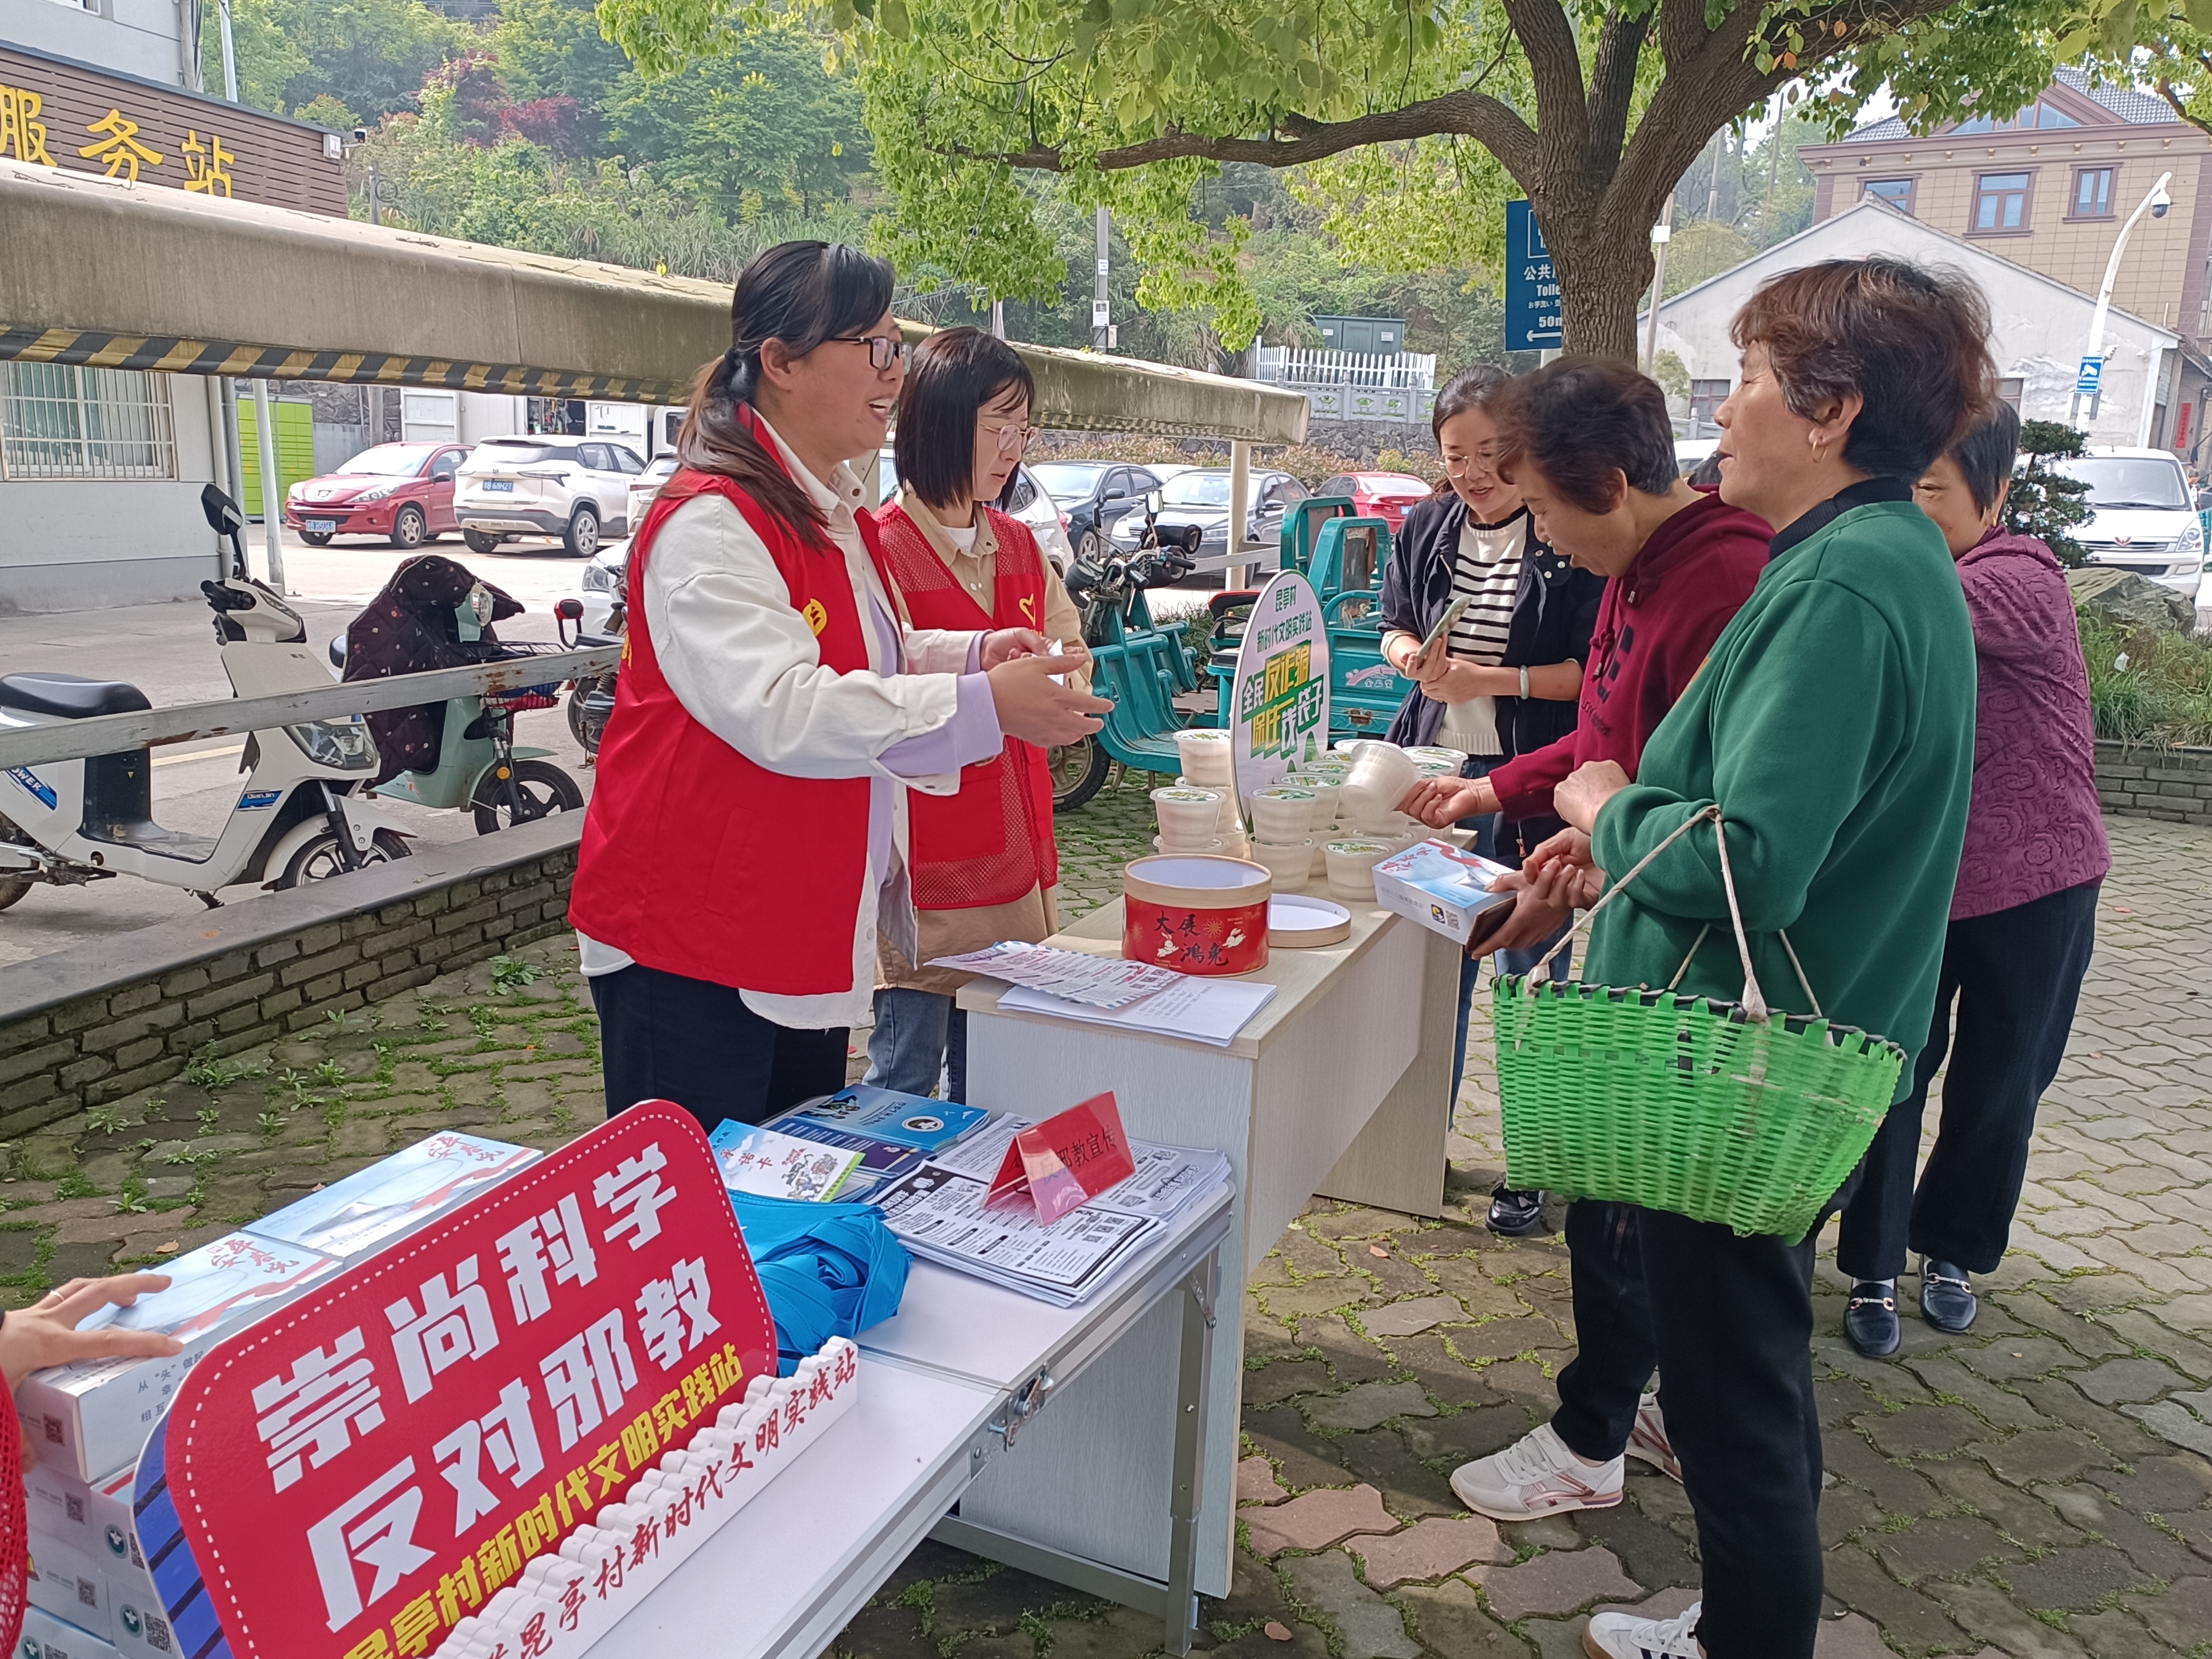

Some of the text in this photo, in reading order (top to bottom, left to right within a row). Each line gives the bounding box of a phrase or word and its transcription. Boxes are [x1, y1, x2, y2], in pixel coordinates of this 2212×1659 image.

[0, 86, 235, 199] 服务站
[1523, 263, 1556, 280] 公共
[1536, 284, 1561, 297] Toile
[1275, 584, 1297, 612] 昆亭村
[1256, 610, 1312, 653] 新时代文明实践站
[1252, 679, 1323, 753] 保住钱袋子
[11, 768, 42, 791] OWER
[1153, 910, 1200, 938] 大展
[718, 1147, 773, 1170] 承诺卡
[251, 1142, 678, 1494] 崇尚科学
[140, 1401, 165, 1423] 相互
[306, 1256, 722, 1634] 反对邪教
[486, 1346, 856, 1659] 昆亭村新时代文明实践站
